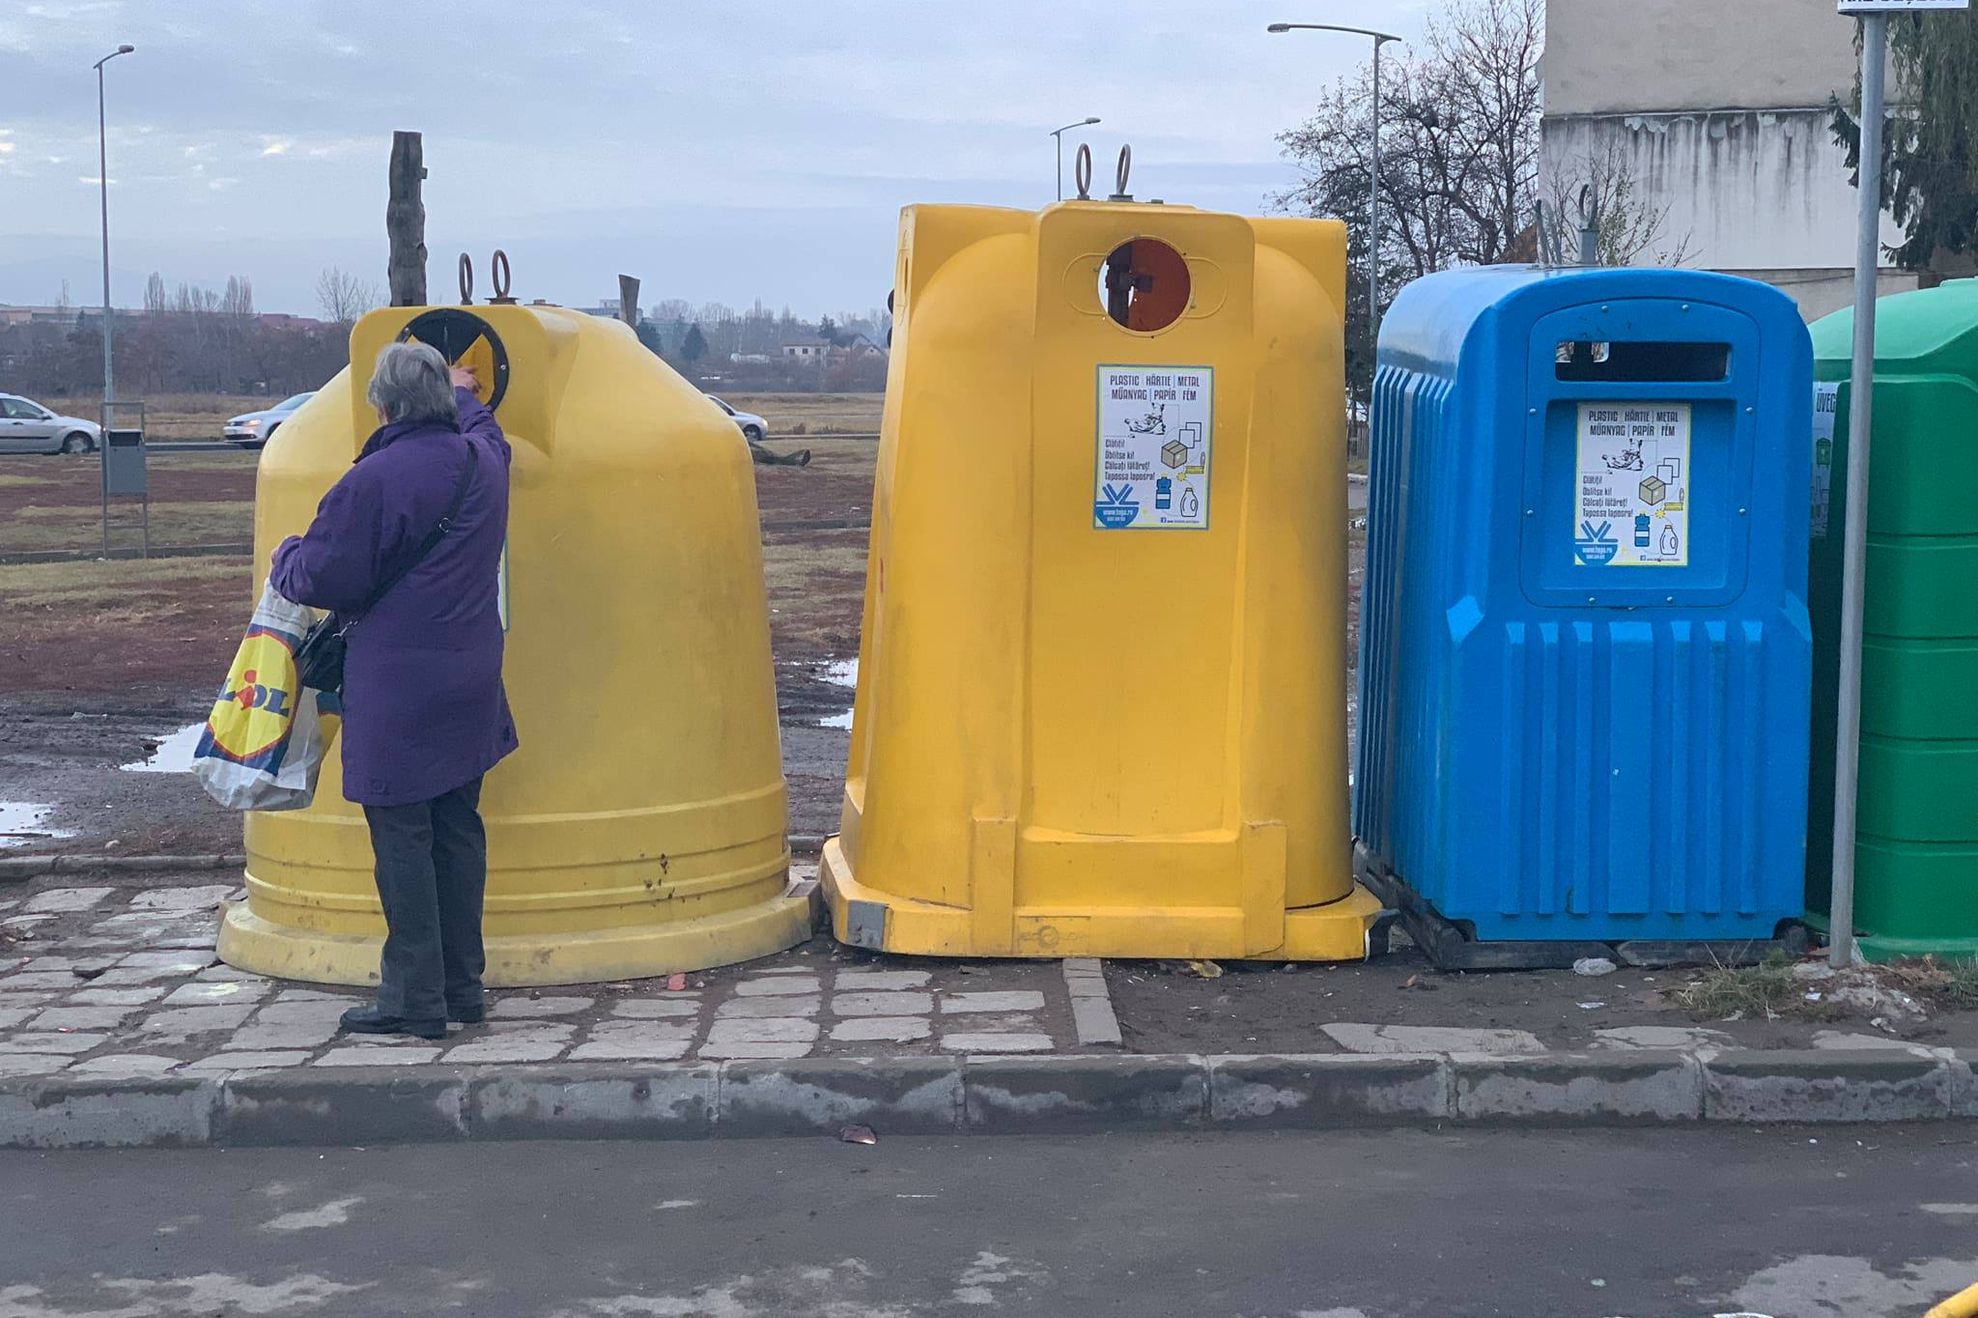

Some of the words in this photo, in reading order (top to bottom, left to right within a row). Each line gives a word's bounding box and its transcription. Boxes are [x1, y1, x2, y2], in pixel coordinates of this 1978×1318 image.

[1110, 375, 1140, 386] PLASTIC
[1177, 375, 1200, 387] METAL
[1154, 388, 1177, 400] PAPÍR
[1183, 388, 1197, 400] FÉM
[1588, 410, 1618, 422] PLASTIC
[1656, 411, 1679, 422] METAL
[1632, 423, 1655, 436] PAPÍR
[1661, 423, 1675, 437] FÉM
